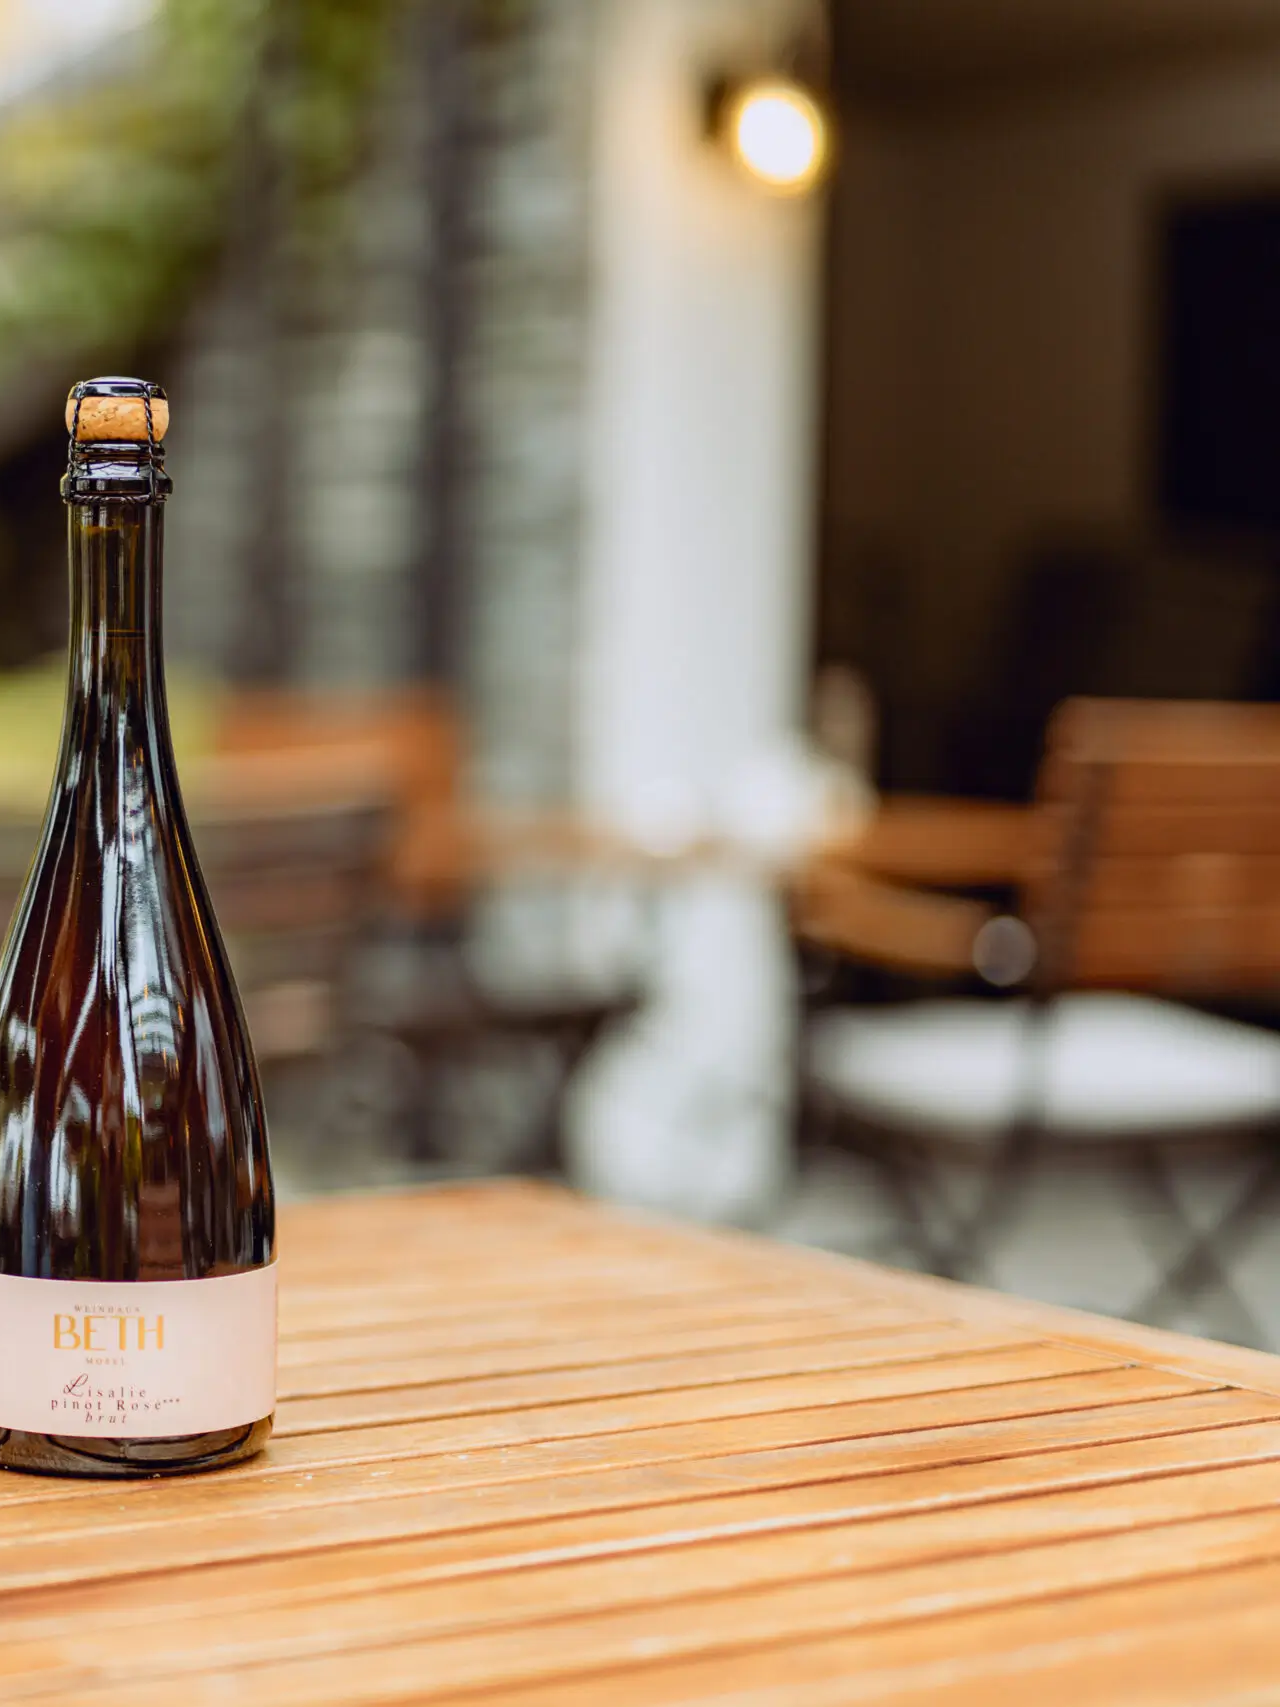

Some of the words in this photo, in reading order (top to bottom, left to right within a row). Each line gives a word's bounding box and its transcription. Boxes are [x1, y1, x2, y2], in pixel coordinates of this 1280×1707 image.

[53, 1314, 164, 1351] BETH
[63, 1373, 147, 1398] Lisalie
[51, 1398, 102, 1411] pinot
[85, 1411, 128, 1424] brut
